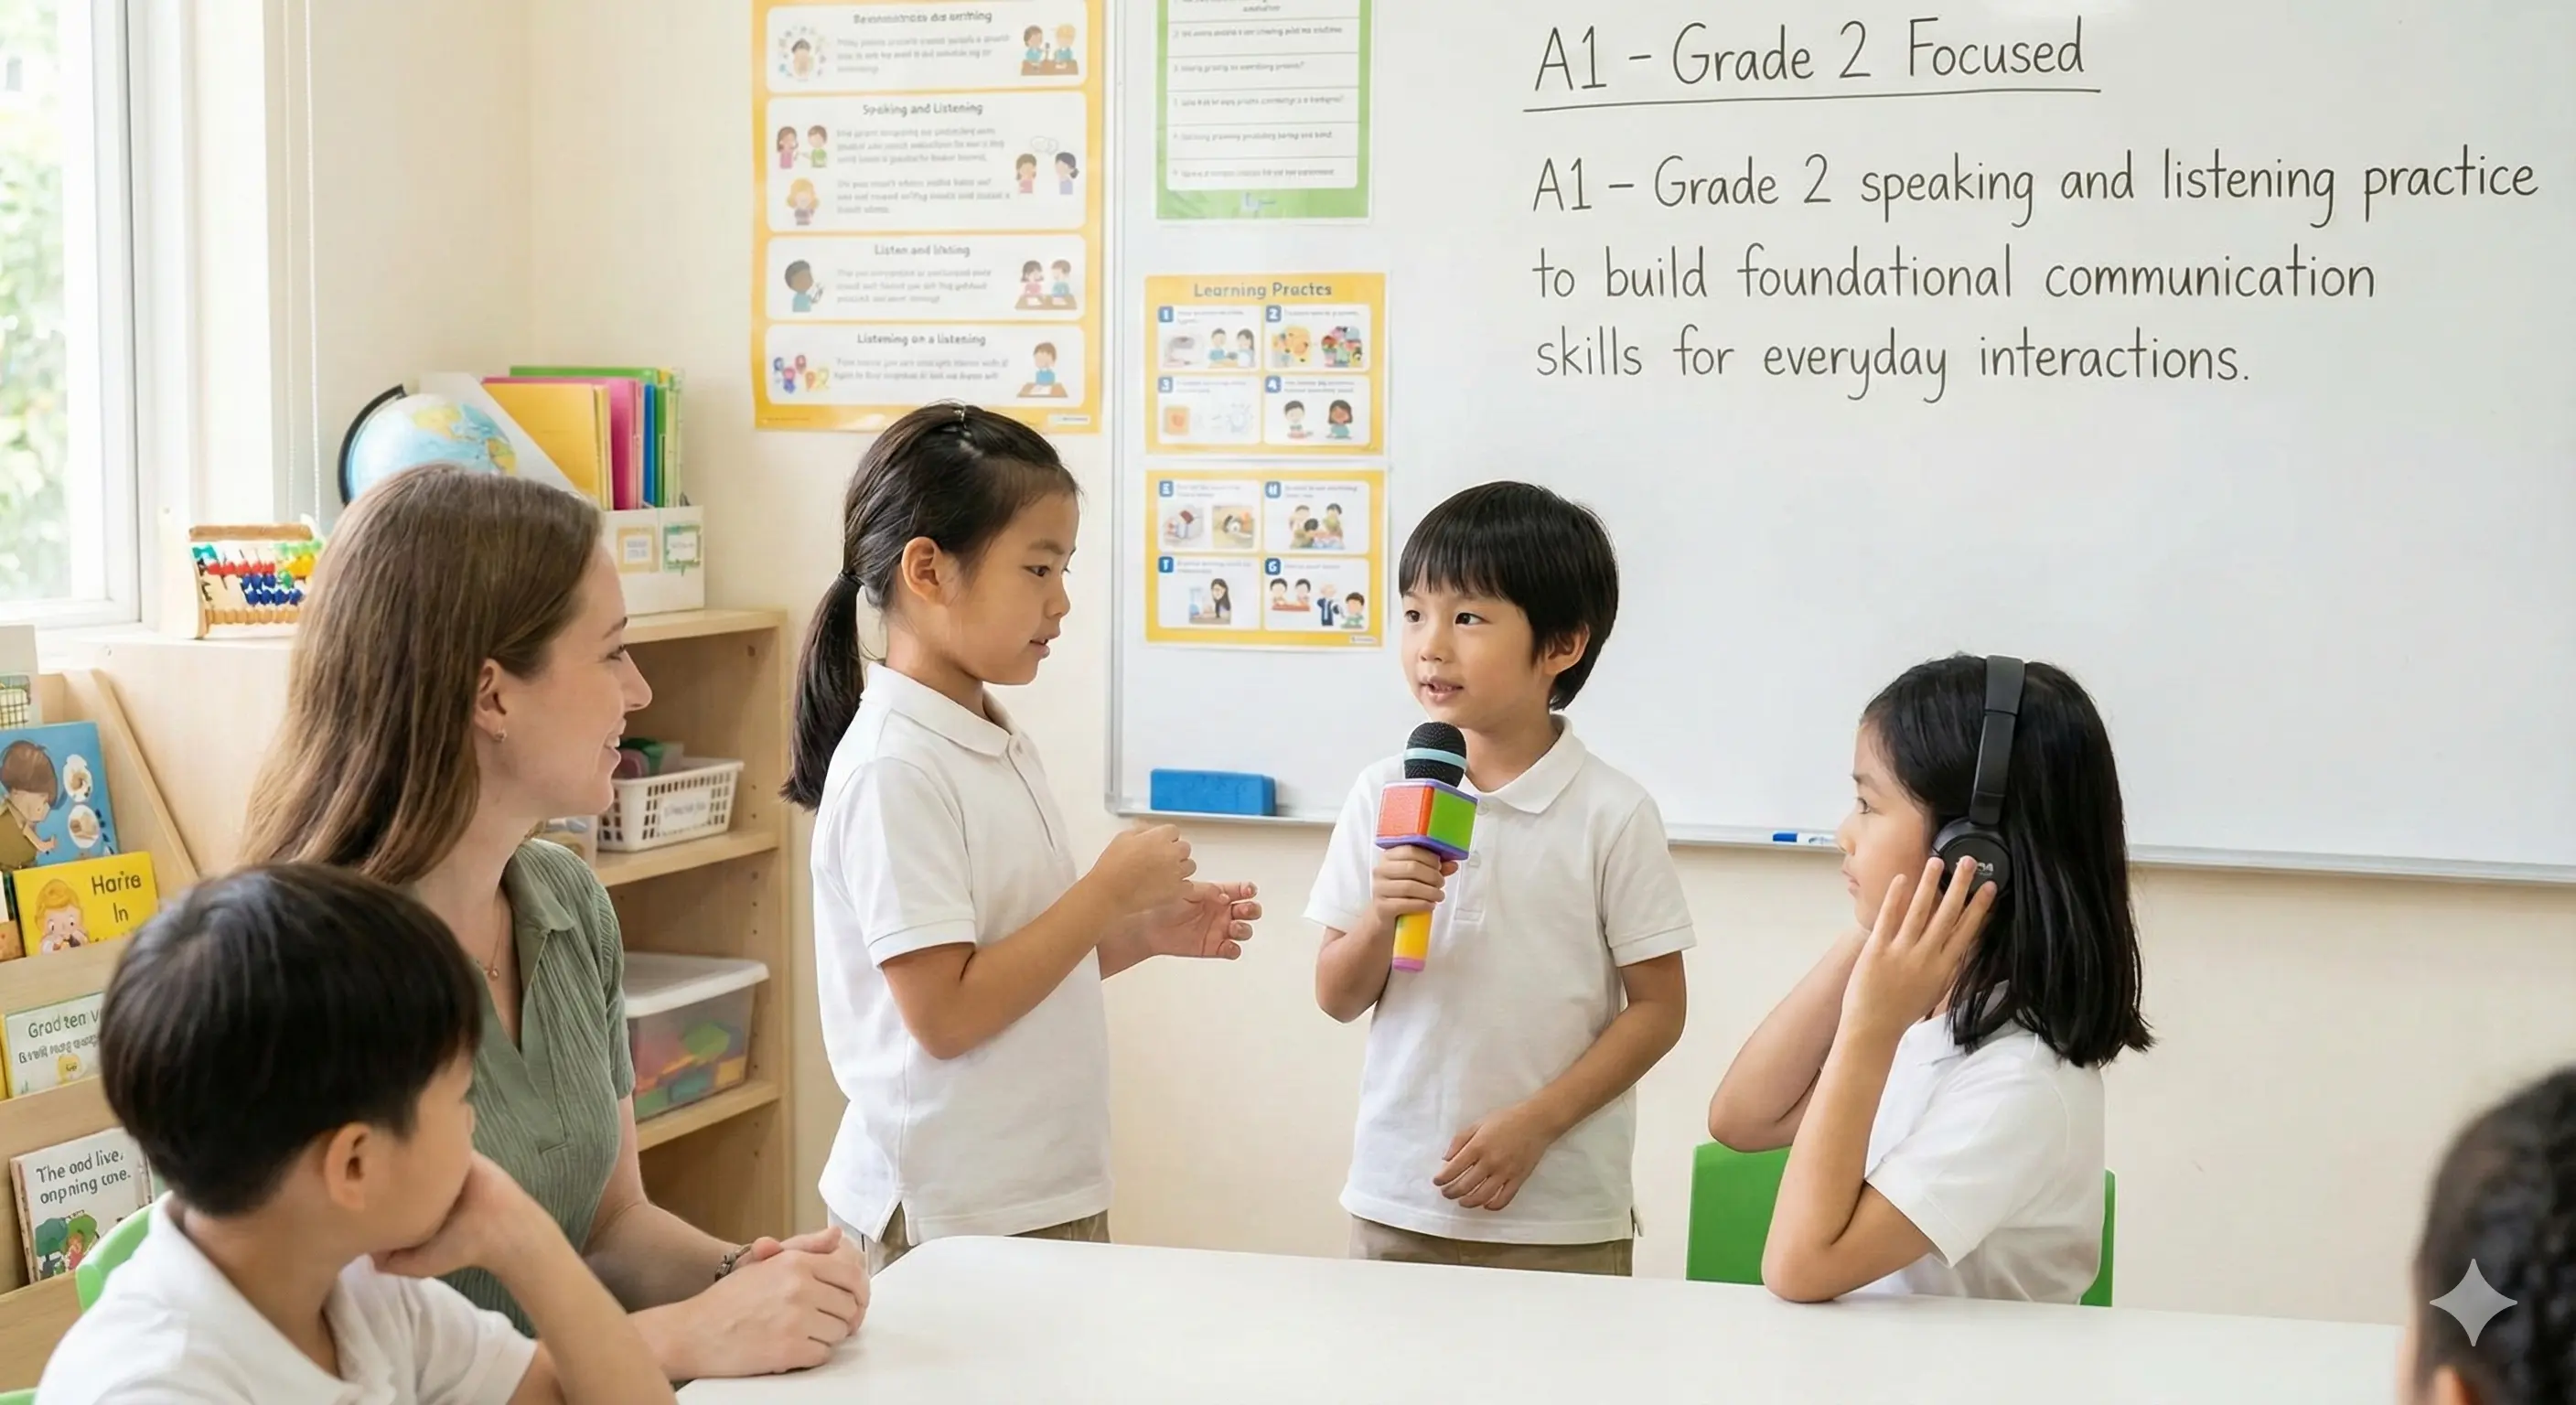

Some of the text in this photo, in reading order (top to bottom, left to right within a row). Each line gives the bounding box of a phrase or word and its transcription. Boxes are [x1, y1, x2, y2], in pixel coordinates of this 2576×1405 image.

[1534, 14, 2085, 92] A1 - Grade 2 Focused
[910, 102, 931, 114] and
[933, 101, 983, 116] Listening
[1532, 156, 1593, 212] A1
[1654, 155, 1779, 208] Grade
[1803, 153, 1832, 204] 2
[1861, 151, 2034, 229] speaking
[2060, 148, 2135, 200] and
[2163, 147, 2335, 230] listening
[2363, 143, 2539, 223] practice
[1193, 283, 1267, 300] Learning
[1531, 241, 2375, 299] to build foundational communication
[1536, 323, 2249, 404] skills for everyday interactions.
[36, 1164, 66, 1183] The
